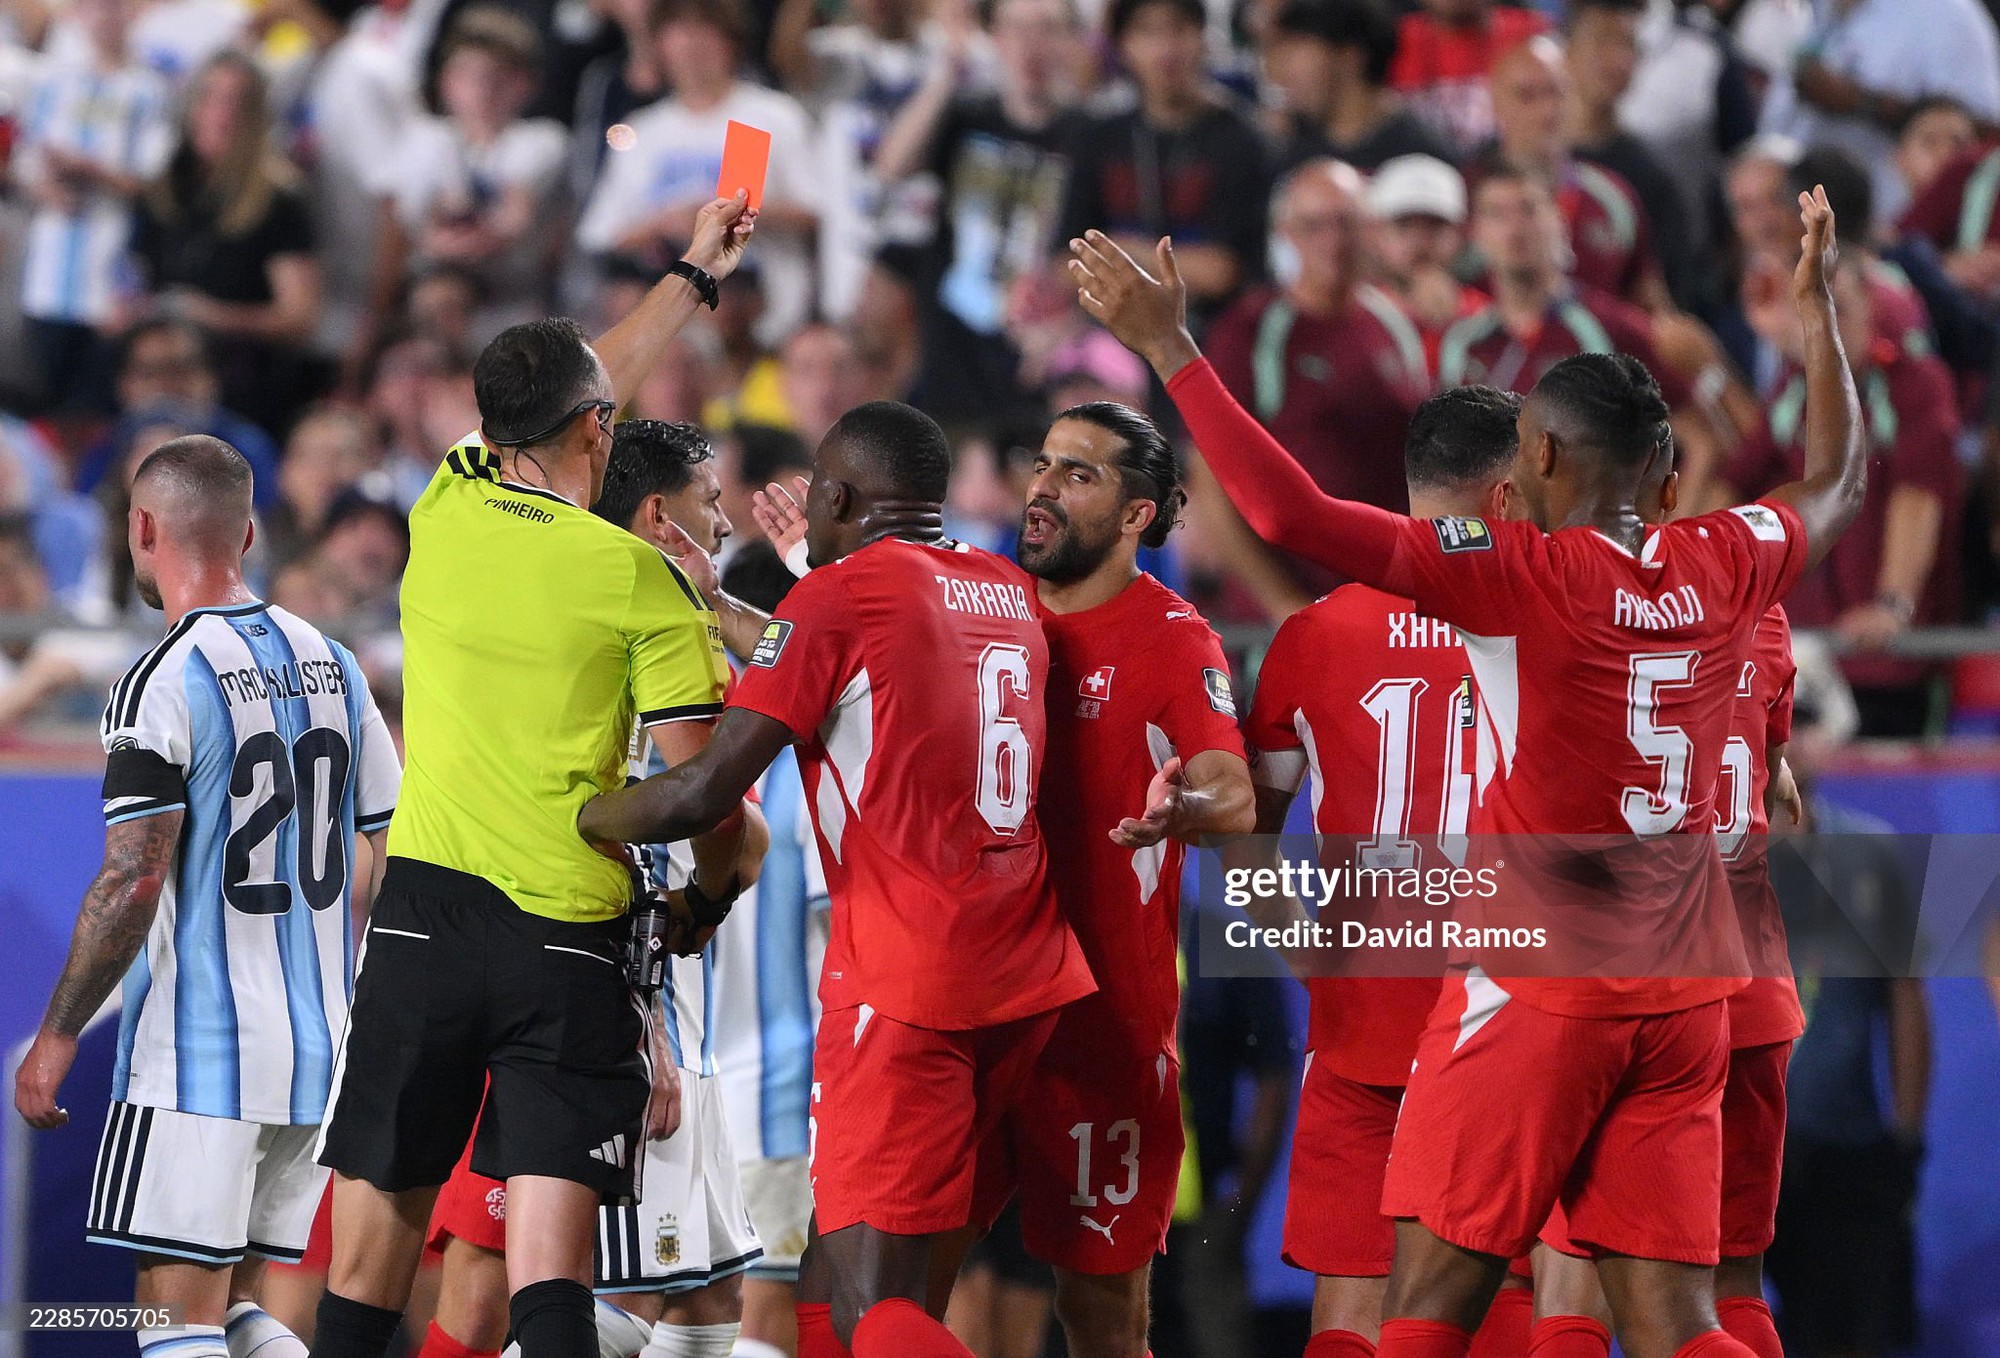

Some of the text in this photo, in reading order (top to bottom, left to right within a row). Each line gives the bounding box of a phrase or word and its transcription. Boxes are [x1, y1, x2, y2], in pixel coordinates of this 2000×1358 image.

[484, 498, 555, 524] PINHEIRO
[934, 575, 1034, 622] ZAKARIA
[1614, 584, 1705, 631] AKANJI
[707, 624, 724, 643] FIF
[217, 666, 268, 708] MAC
[975, 641, 1033, 838] 6
[1620, 650, 1703, 842] 5
[221, 725, 351, 917] 20
[1068, 1117, 1141, 1208] 13
